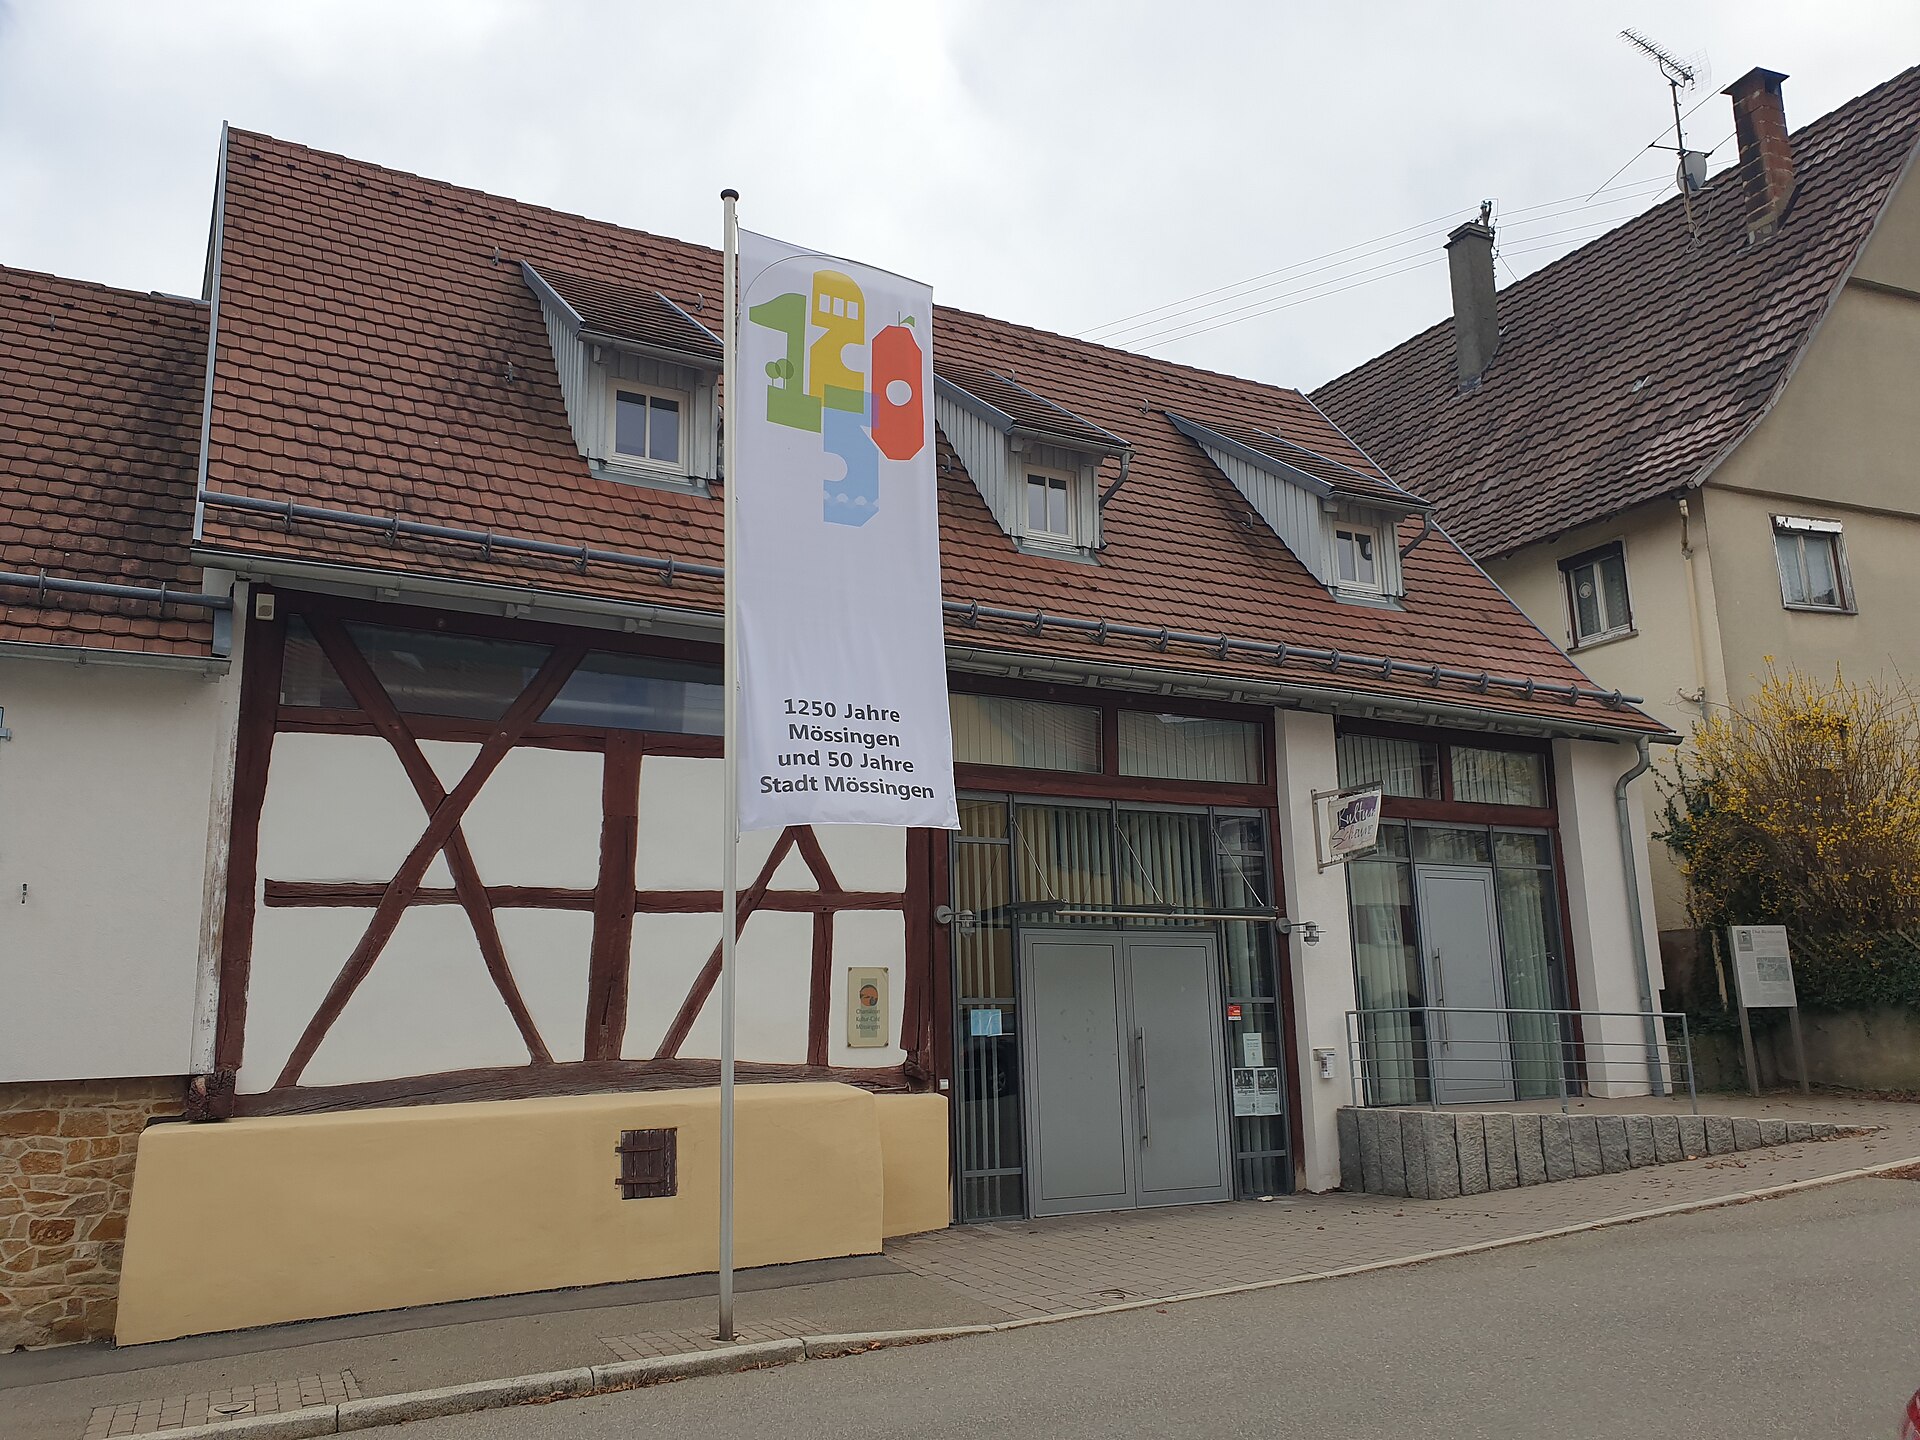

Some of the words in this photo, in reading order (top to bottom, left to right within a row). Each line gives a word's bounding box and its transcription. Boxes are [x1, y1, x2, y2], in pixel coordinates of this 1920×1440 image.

[784, 698, 837, 718] 1250
[844, 703, 901, 723] Jahre
[788, 723, 900, 749] Mössingen
[778, 749, 820, 767] und
[827, 751, 853, 768] 50
[860, 753, 914, 773] Jahre
[760, 774, 819, 794] Stadt
[824, 775, 935, 801] Mössingen
